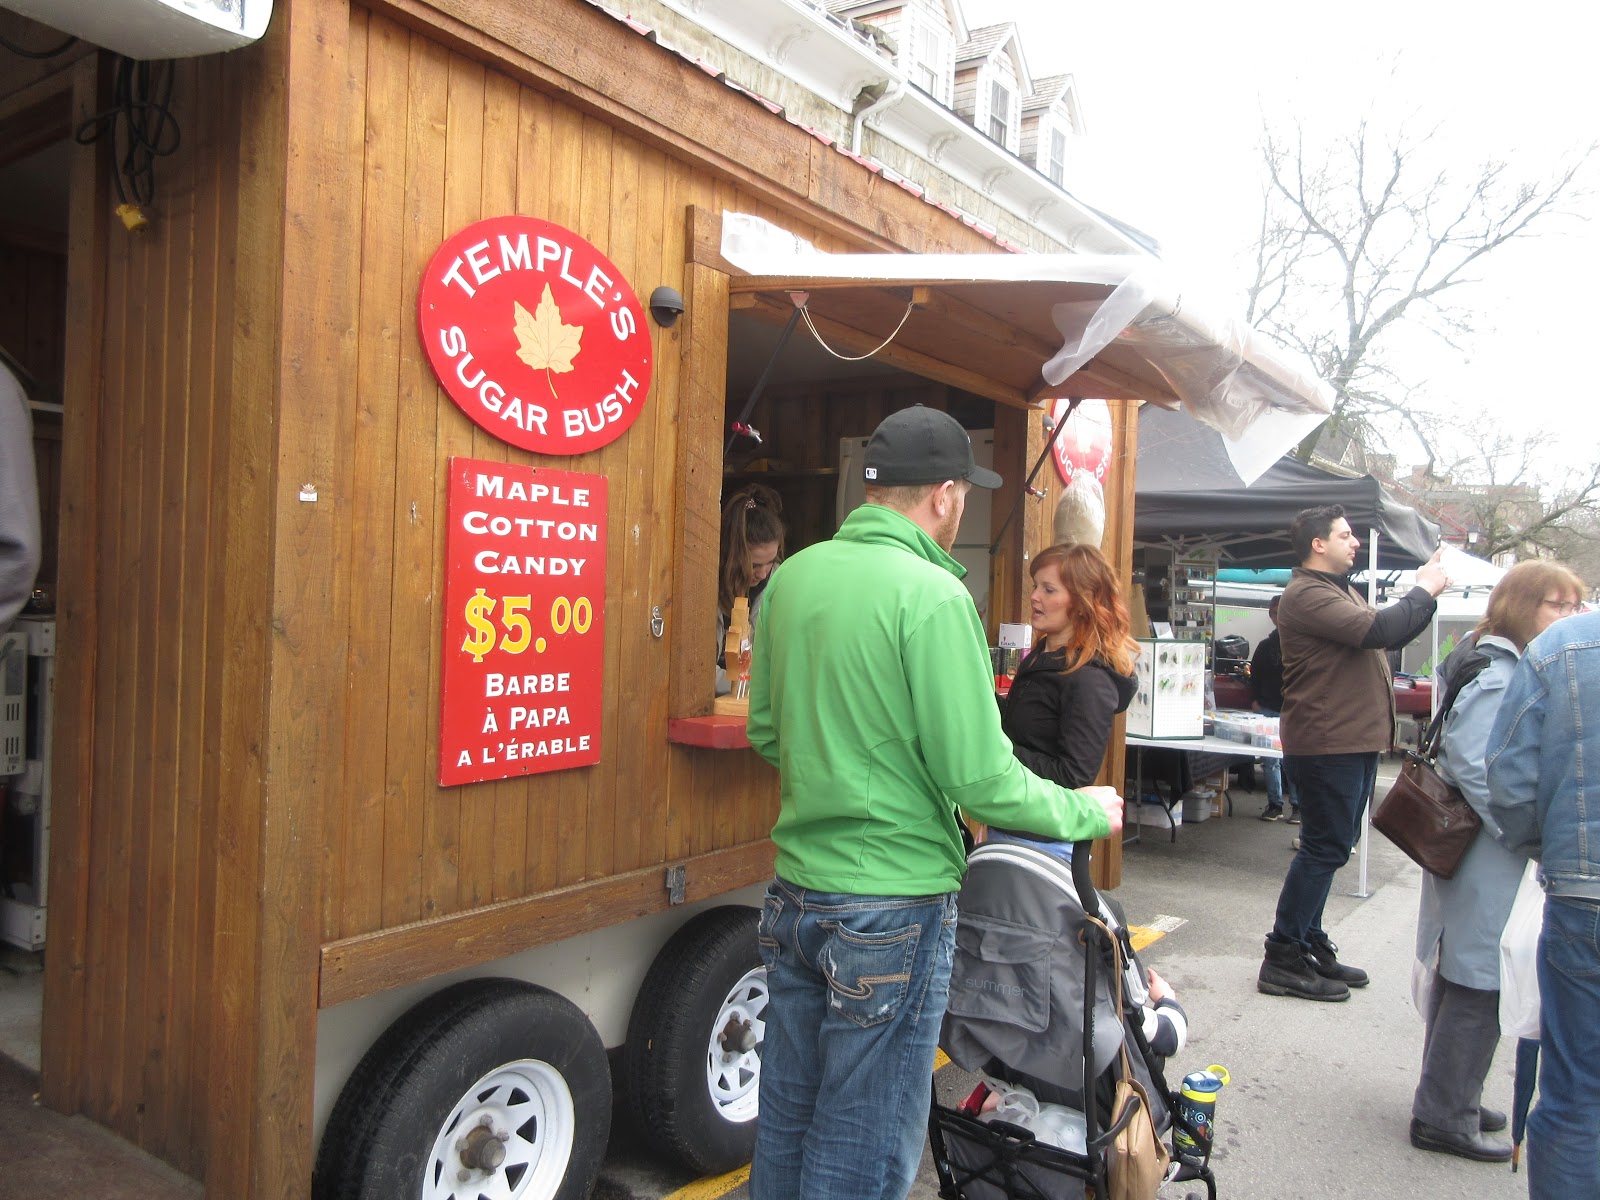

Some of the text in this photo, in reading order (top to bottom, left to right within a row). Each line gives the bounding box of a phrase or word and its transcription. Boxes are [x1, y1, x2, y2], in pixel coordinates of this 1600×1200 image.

[441, 234, 637, 342] TEMPLE'S
[440, 325, 639, 438] SUGAR BUSH
[475, 473, 590, 508] MAPLE
[462, 511, 598, 542] COTTON
[474, 550, 587, 577] CANDY
[486, 672, 571, 697] BARBE
[482, 706, 571, 734] À PAPA
[456, 735, 591, 767] A L'ÉRABLE
[965, 977, 1026, 998] summer
